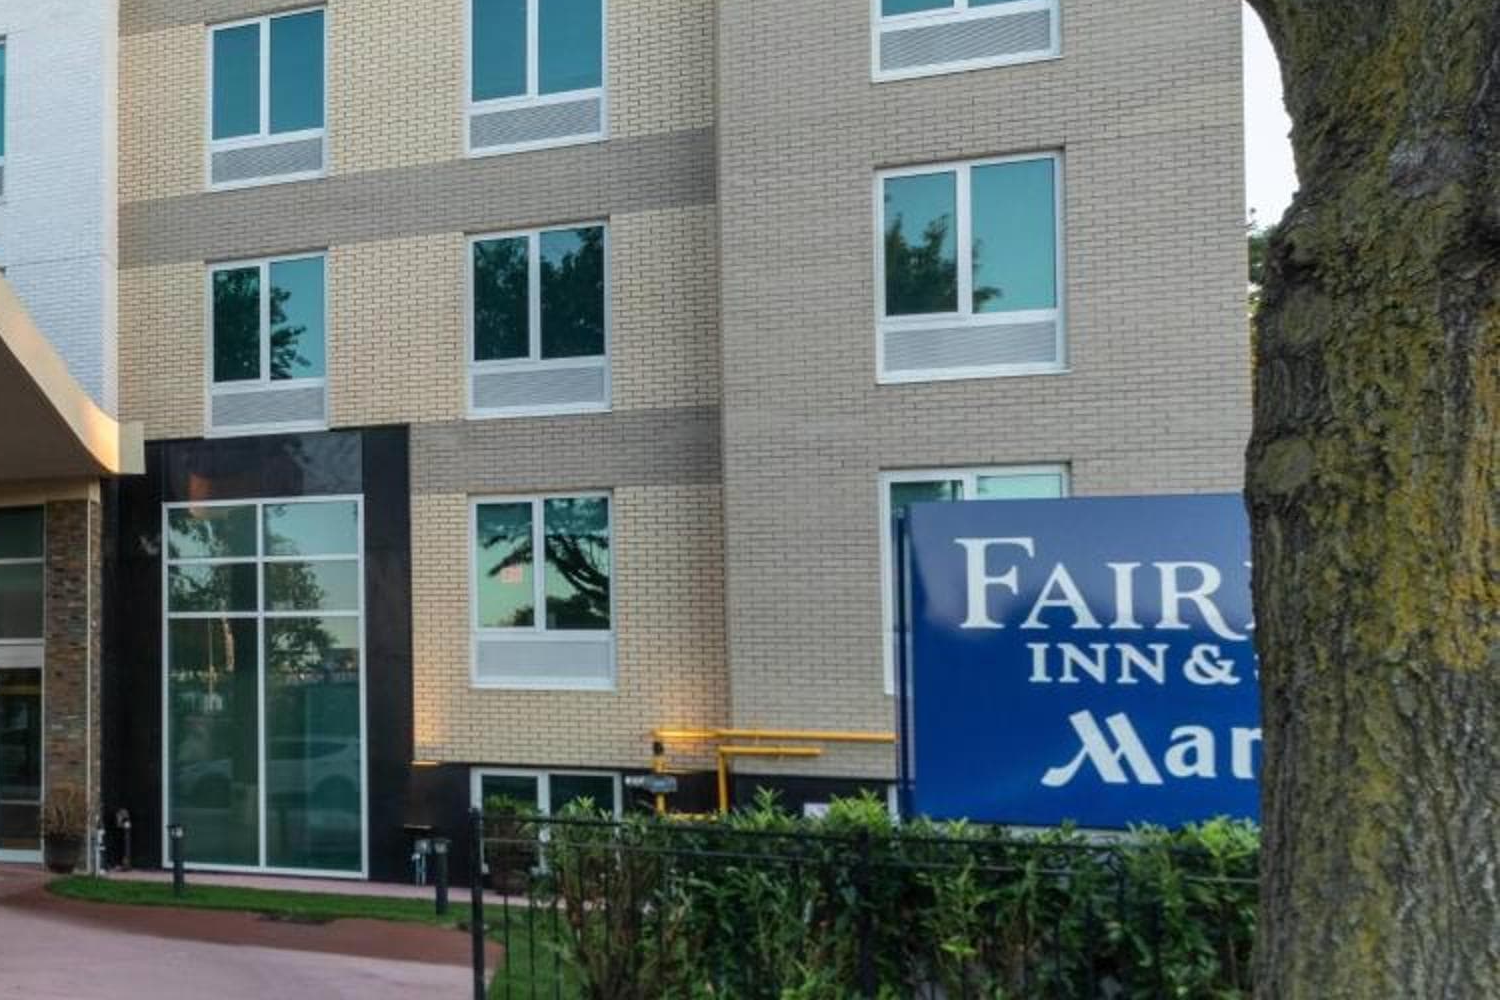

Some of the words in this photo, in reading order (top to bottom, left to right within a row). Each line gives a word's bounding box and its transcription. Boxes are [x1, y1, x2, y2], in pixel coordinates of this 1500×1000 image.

[954, 536, 1255, 641] FAIR
[1026, 642, 1170, 684] INN
[1182, 644, 1242, 685] &
